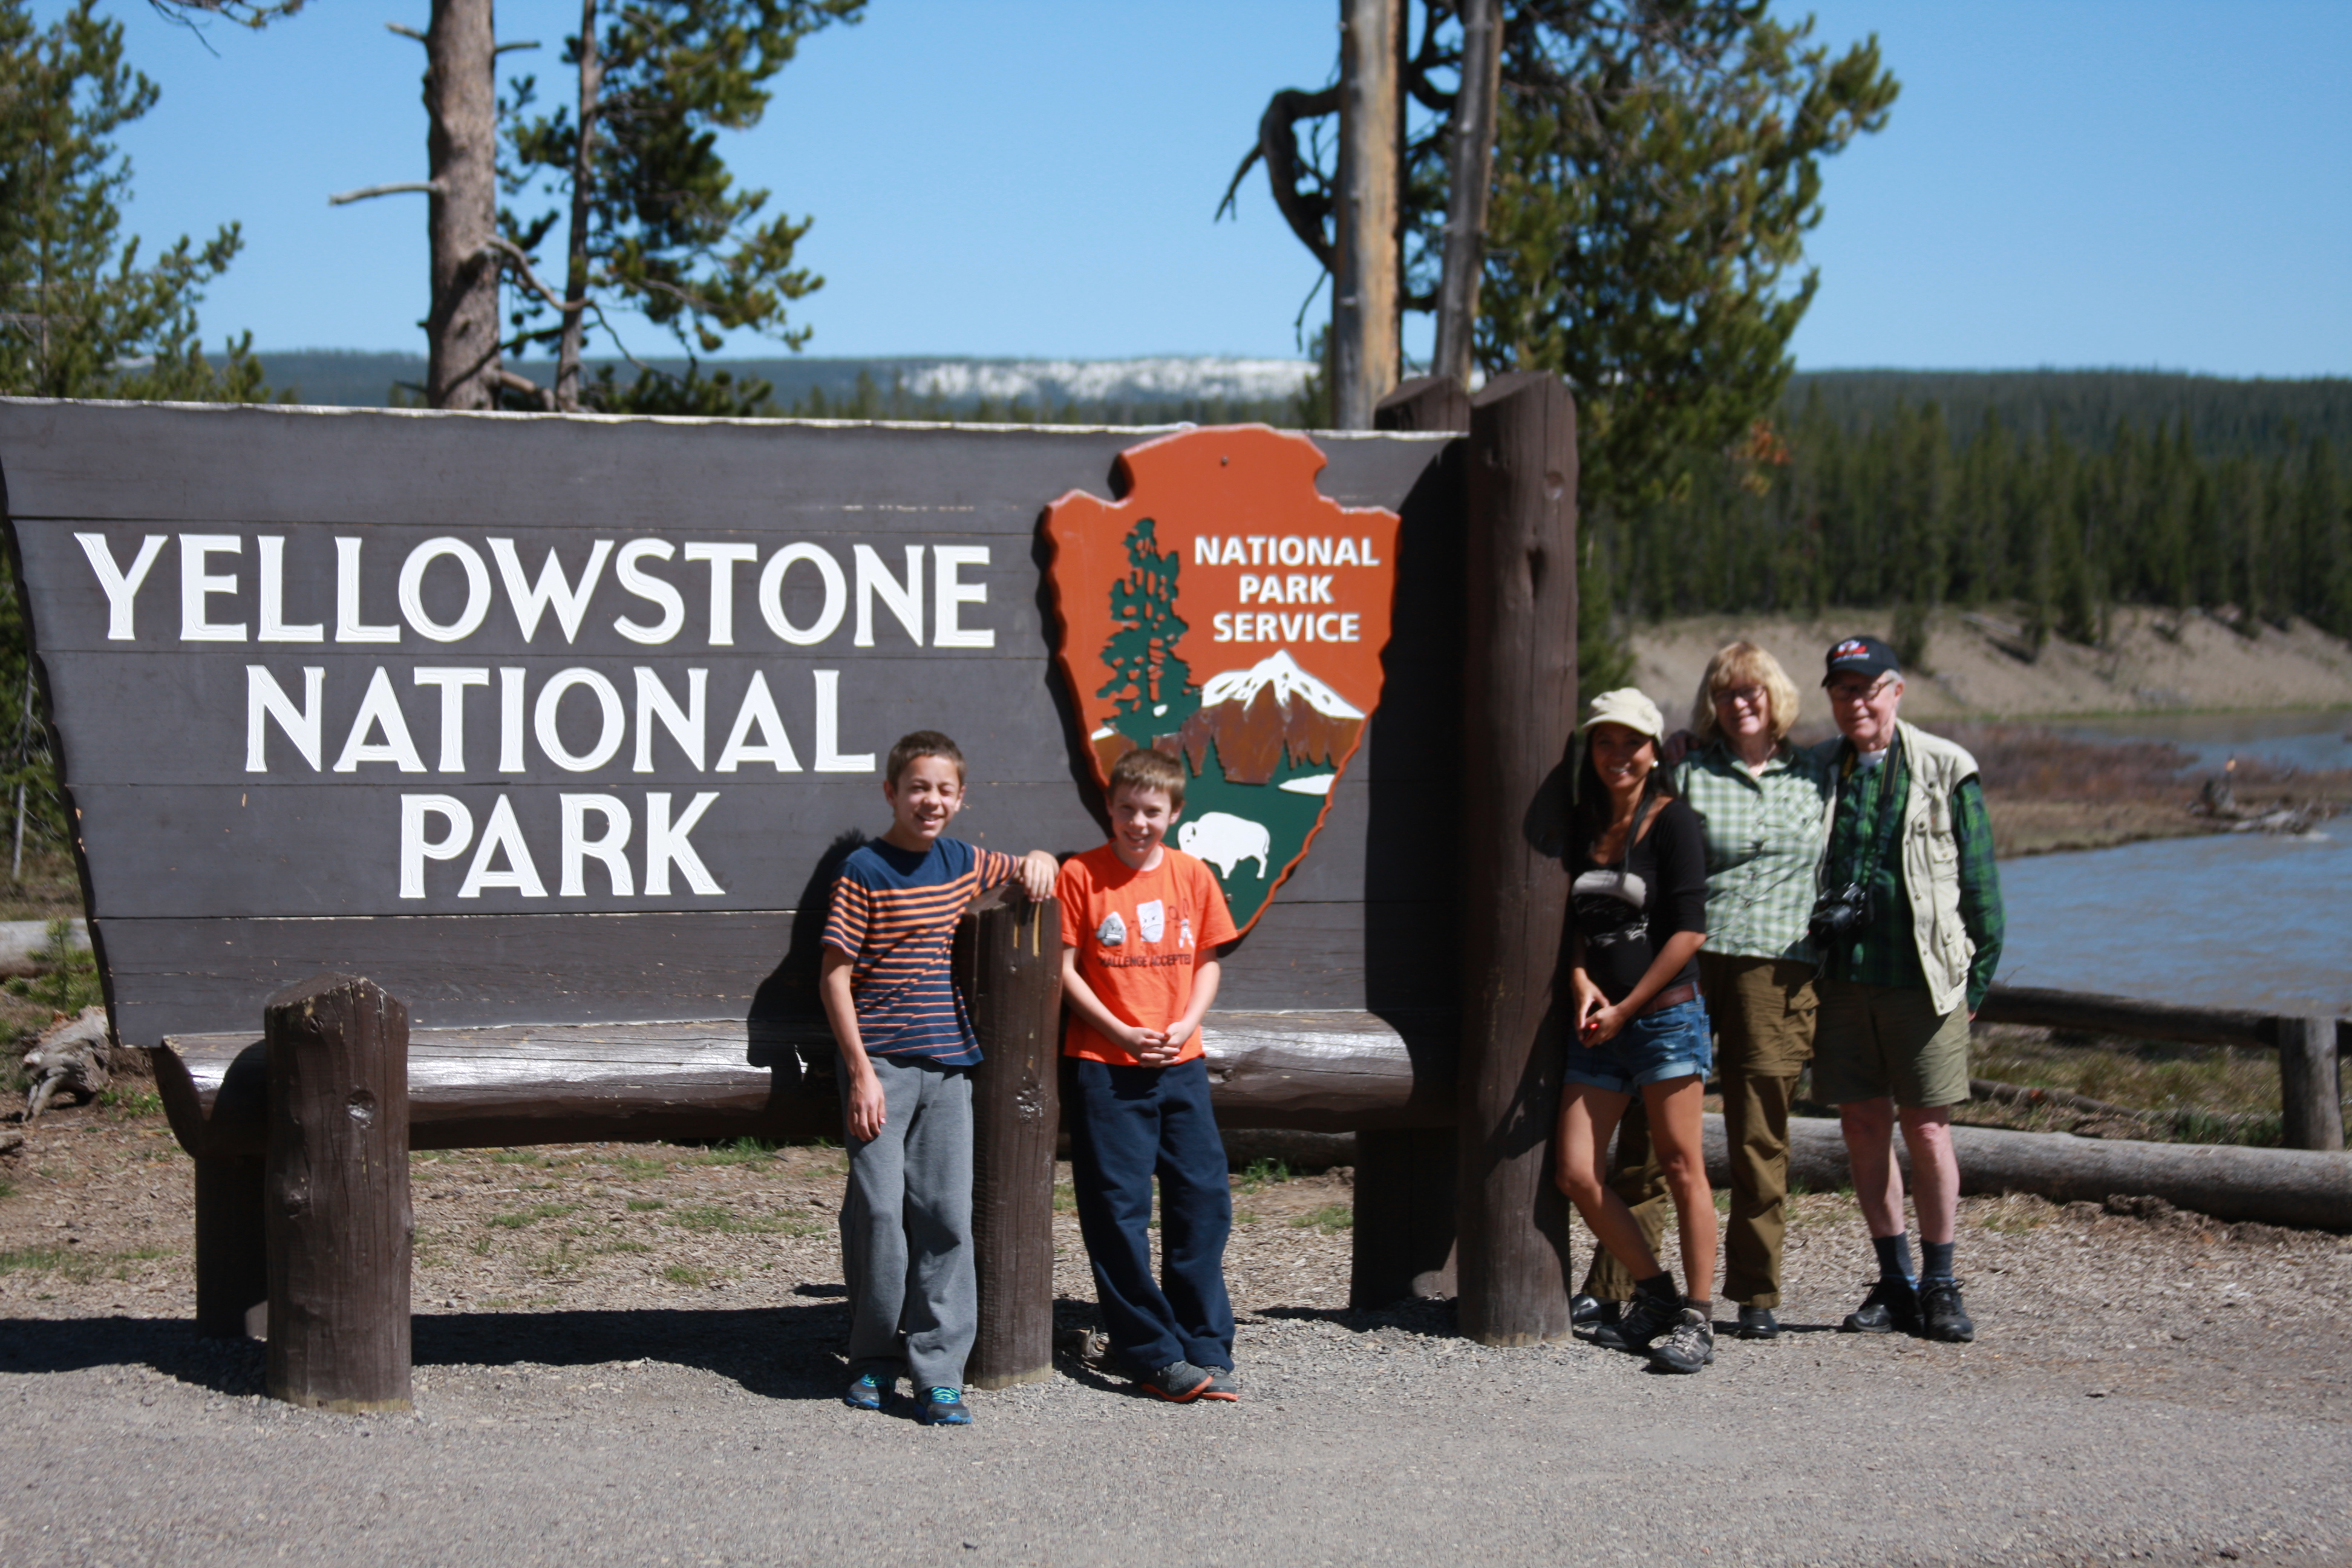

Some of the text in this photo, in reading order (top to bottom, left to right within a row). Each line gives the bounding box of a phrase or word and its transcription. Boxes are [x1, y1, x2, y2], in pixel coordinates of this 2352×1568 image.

[1194, 535, 1381, 567] NATIONAL
[73, 532, 996, 648] YELLOWSTONE
[1238, 573, 1334, 604] PARK
[1212, 610, 1361, 642] SERVICE
[245, 665, 877, 773] NATIONAL
[399, 791, 727, 900] PARK
